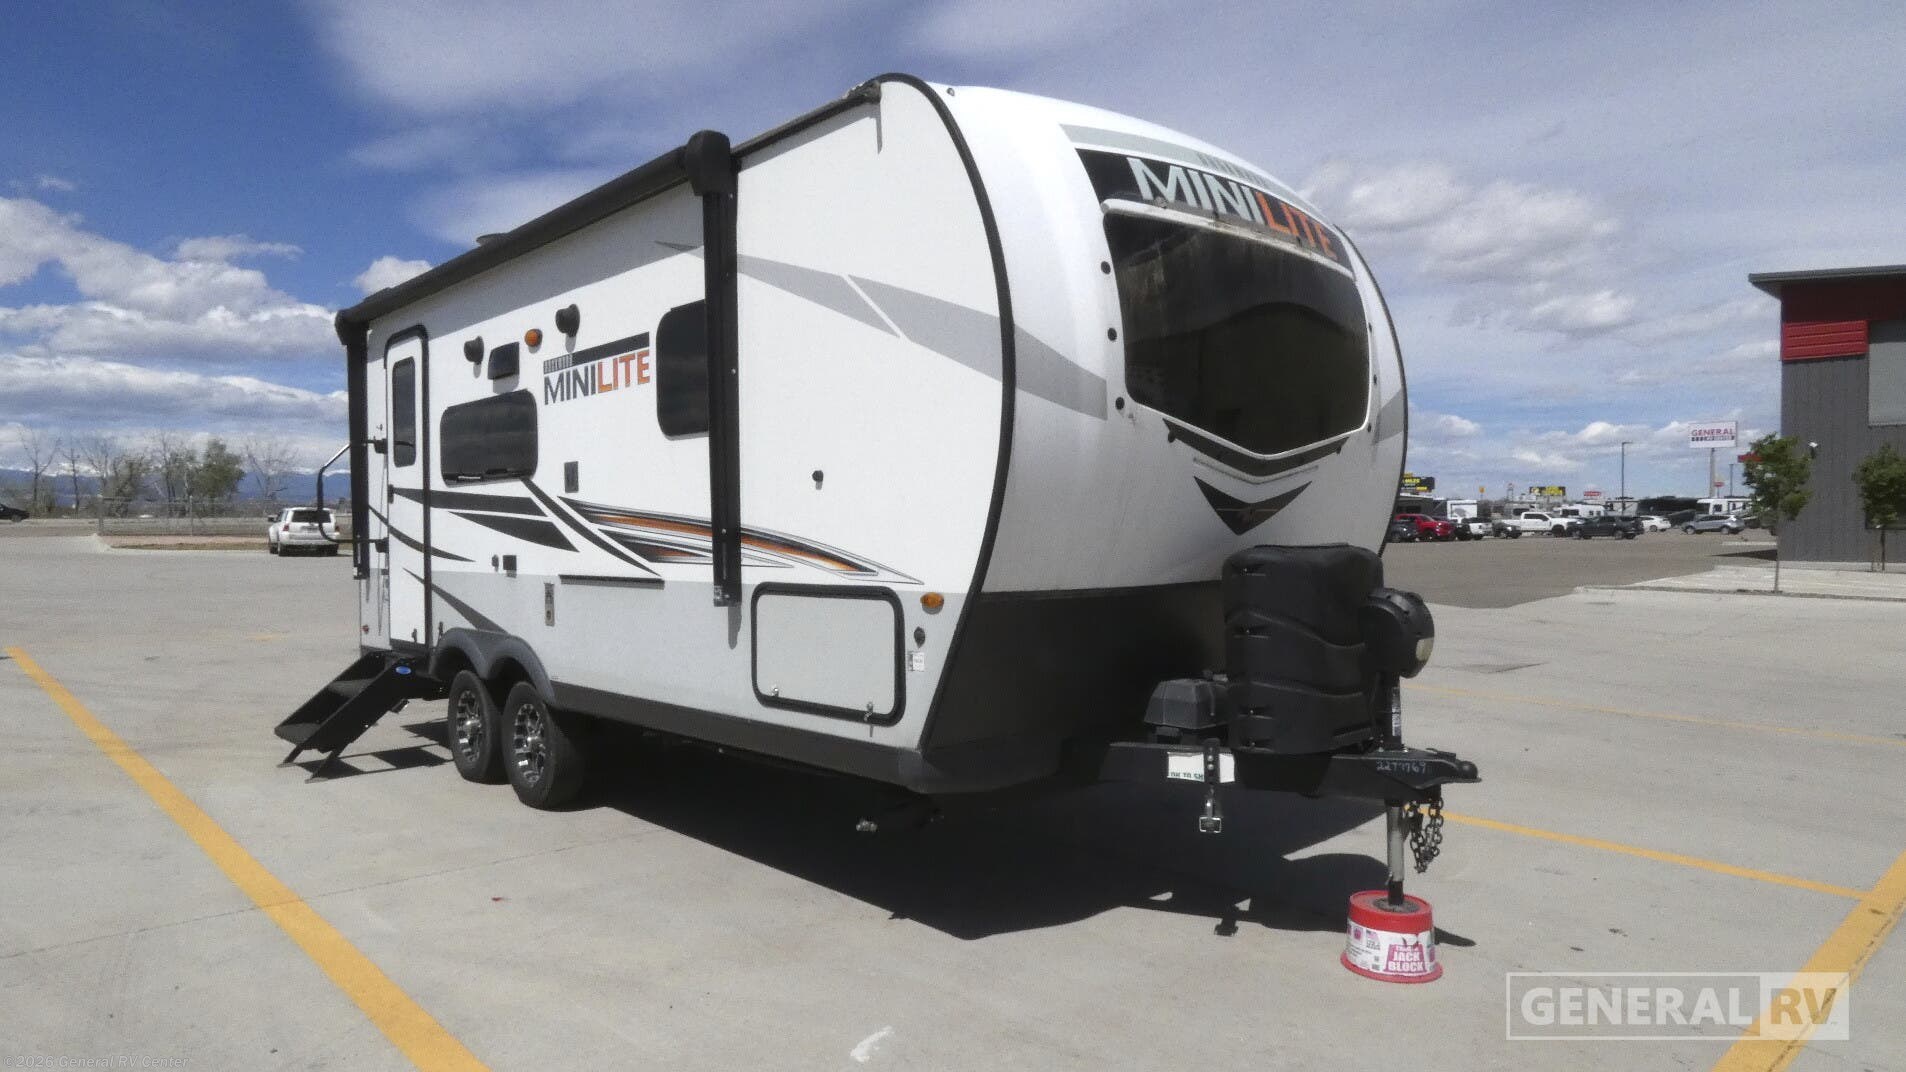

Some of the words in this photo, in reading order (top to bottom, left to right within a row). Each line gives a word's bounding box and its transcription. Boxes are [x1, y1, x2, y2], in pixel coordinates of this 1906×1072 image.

[1691, 428, 1733, 437] GENERAL
[1393, 951, 1420, 962] JACK
[1388, 961, 1424, 972] BLOCK
